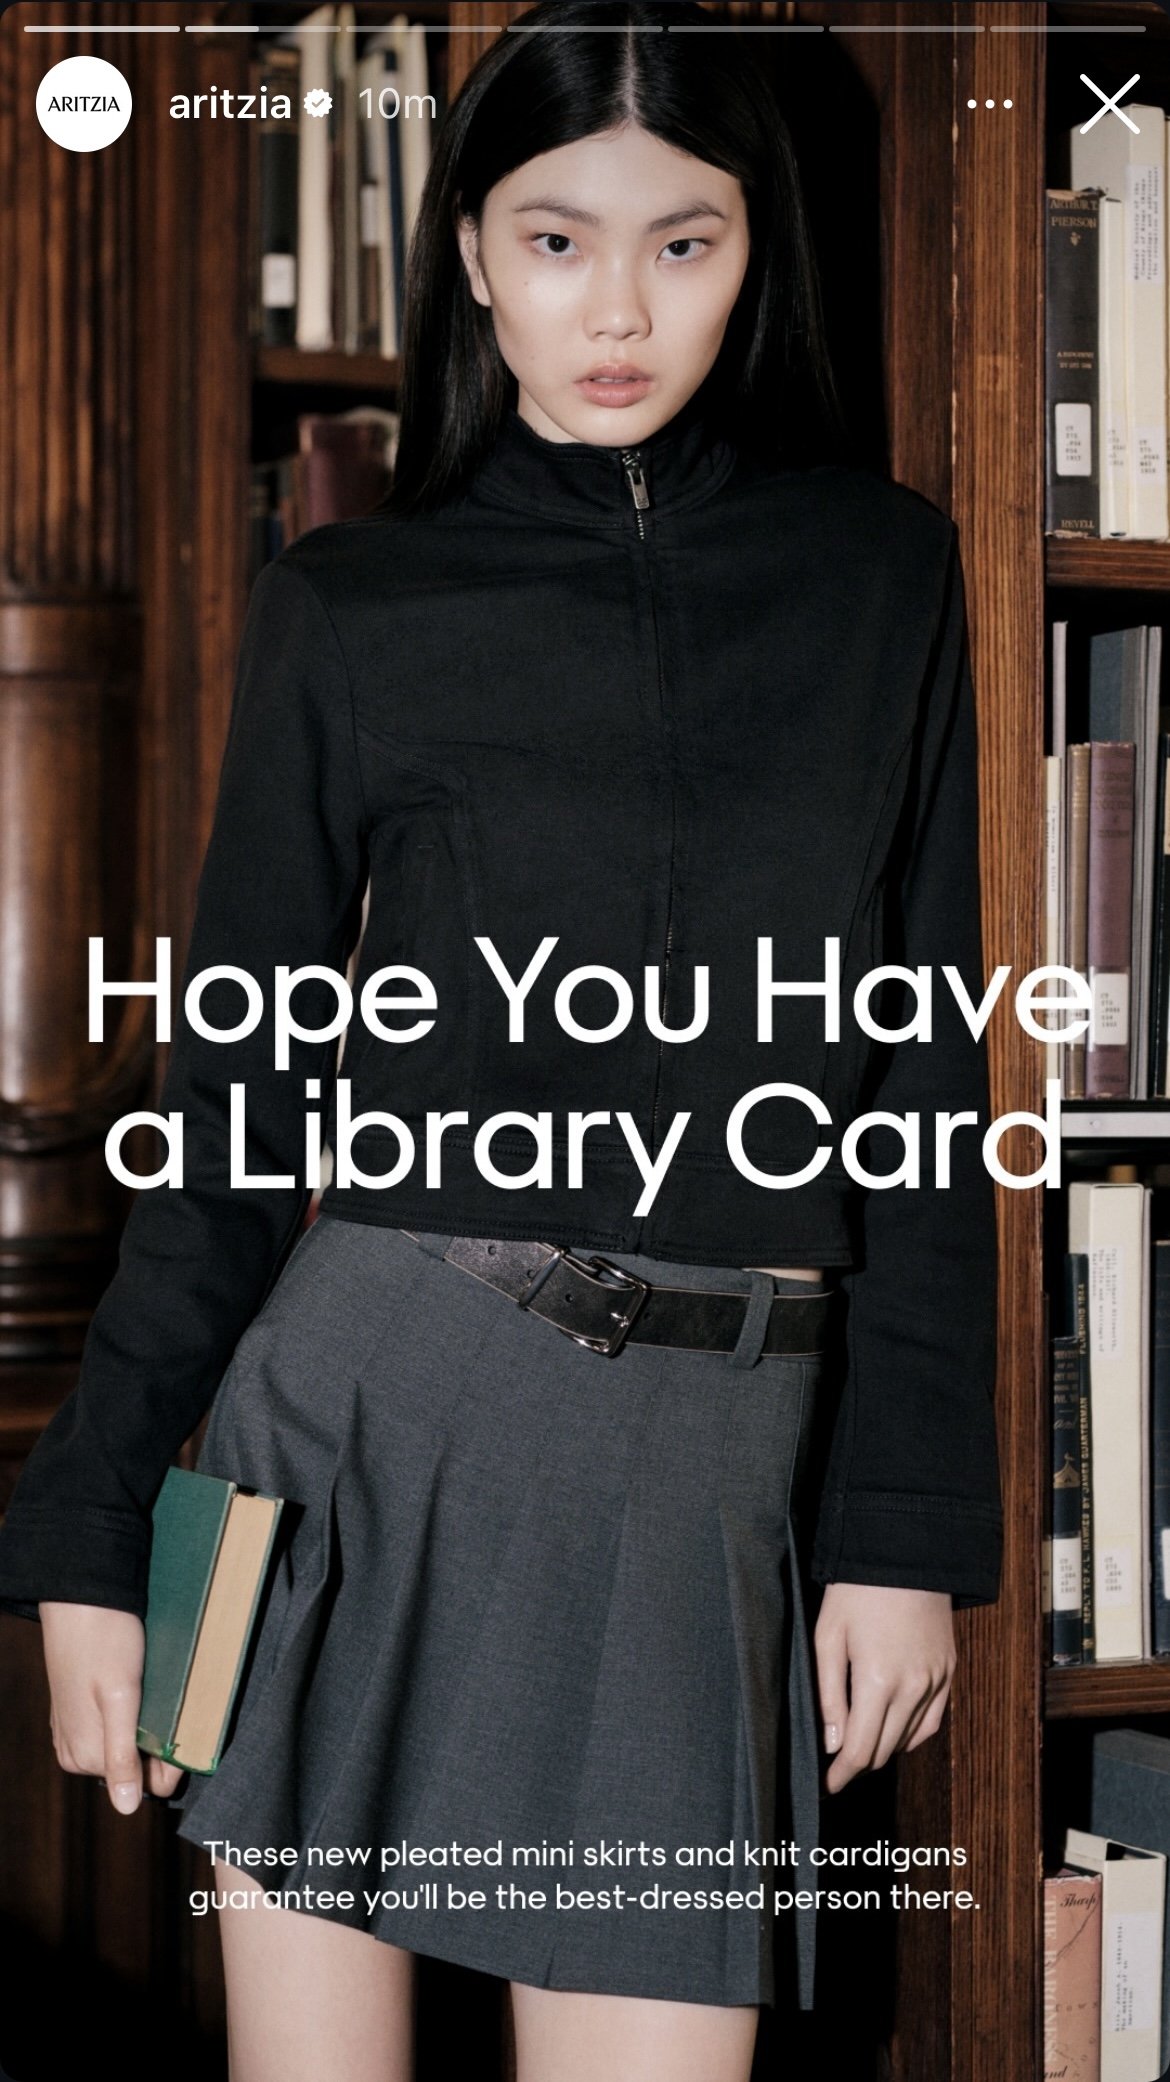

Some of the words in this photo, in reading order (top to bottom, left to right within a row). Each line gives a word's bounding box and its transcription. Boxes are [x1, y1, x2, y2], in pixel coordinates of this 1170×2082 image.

[1051, 216, 1097, 228] PIERSON
[1061, 519, 1095, 529] REVELL
[1079, 1397, 1089, 1459] QUARTERMAN
[1081, 1462, 1089, 1493] JAMES
[1082, 1497, 1090, 1509] BY
[1082, 1514, 1090, 1551] HAWKES
[1083, 1577, 1091, 1590] TO
[1083, 1594, 1091, 1624] REPLY
